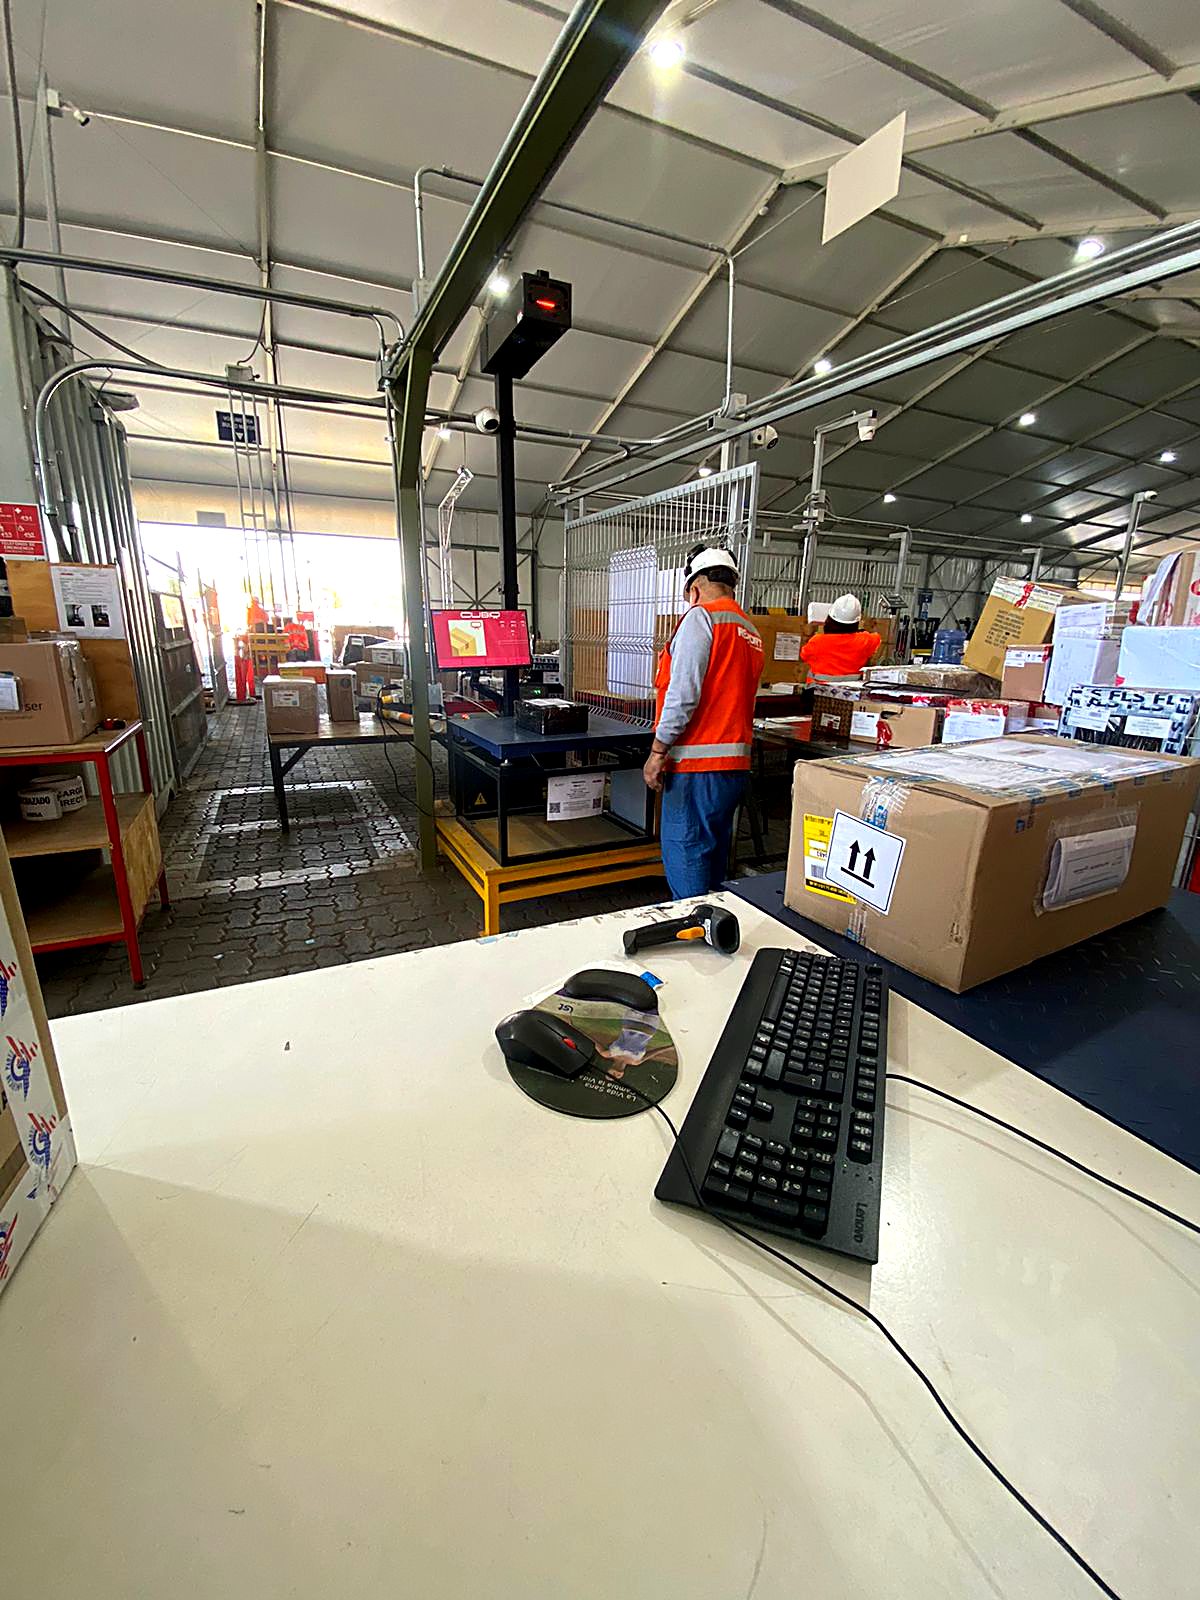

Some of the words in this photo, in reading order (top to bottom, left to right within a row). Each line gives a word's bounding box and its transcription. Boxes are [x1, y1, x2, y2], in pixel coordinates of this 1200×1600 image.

[1108, 690, 1145, 703] FLS
[584, 1082, 606, 1093] Sana
[606, 1089, 624, 1099] Vida
[854, 1202, 868, 1243] Lenovo
